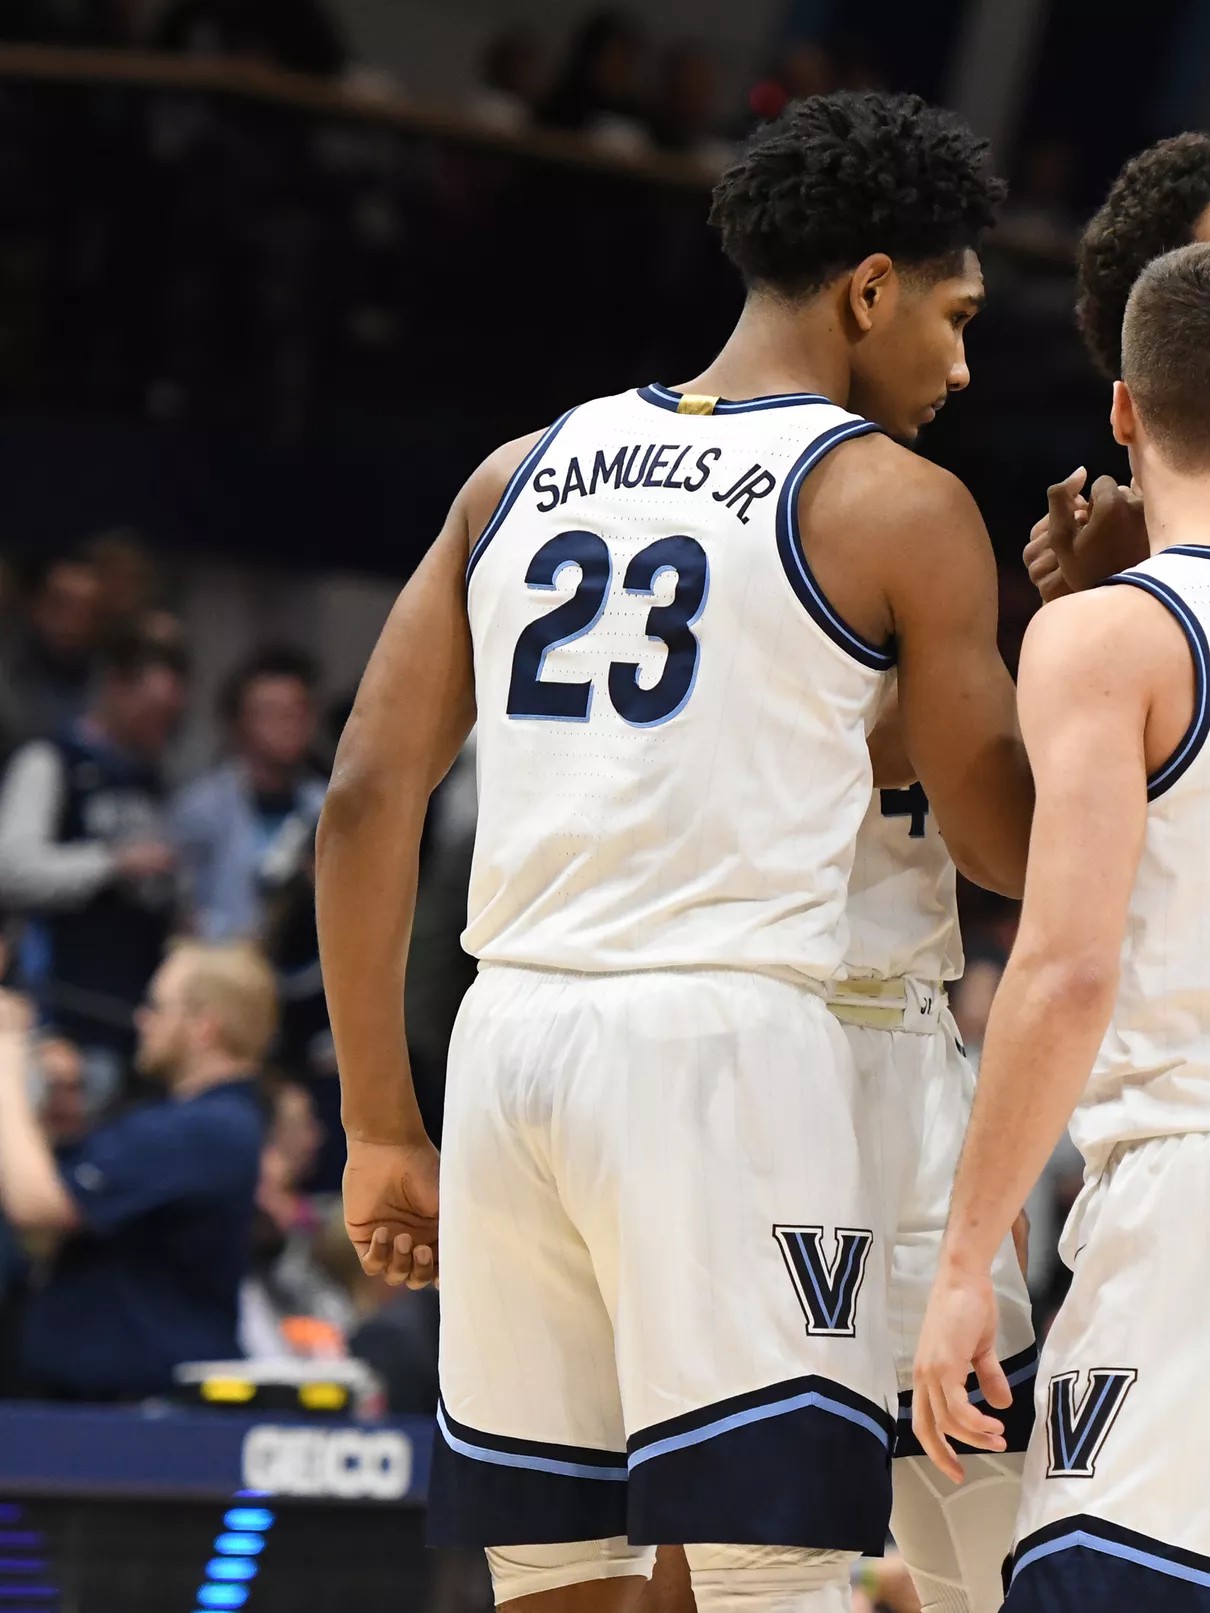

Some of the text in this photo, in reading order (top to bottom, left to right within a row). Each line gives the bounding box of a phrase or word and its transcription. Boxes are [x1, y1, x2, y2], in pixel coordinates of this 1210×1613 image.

[532, 444, 722, 513] SAMUELS
[506, 530, 711, 728] 23
[772, 1223, 874, 1338] V
[1045, 1367, 1139, 1479] V
